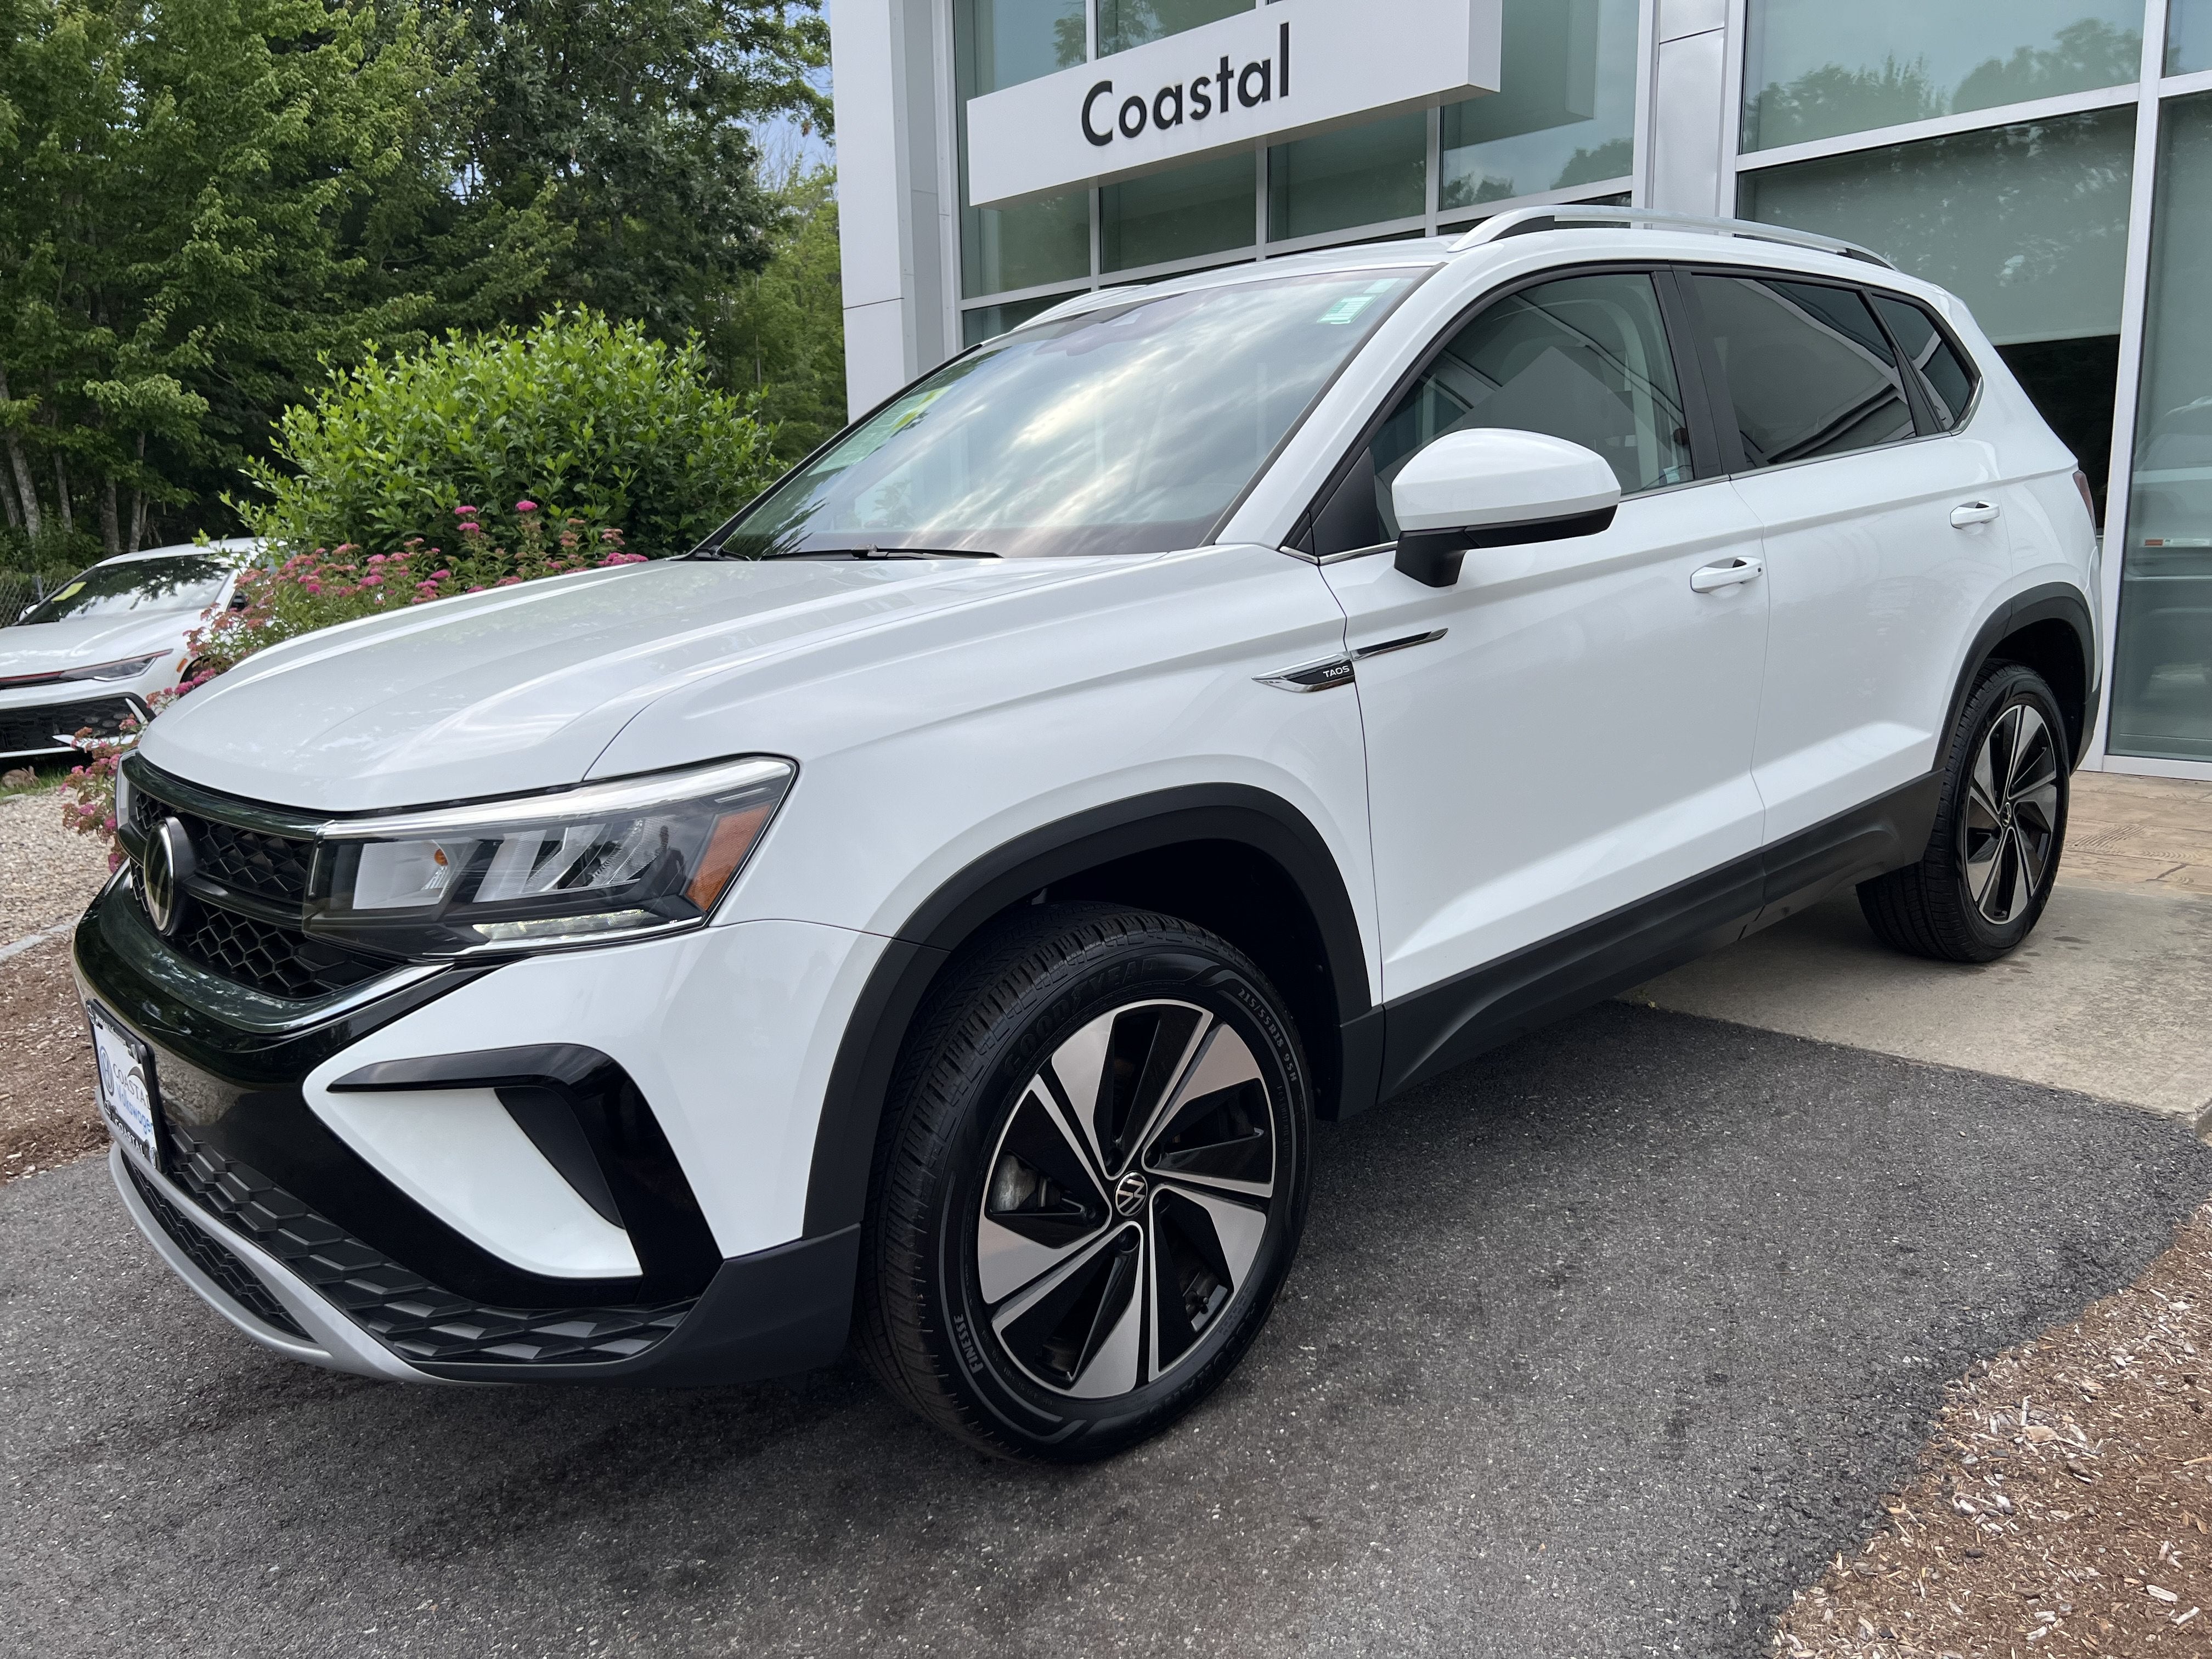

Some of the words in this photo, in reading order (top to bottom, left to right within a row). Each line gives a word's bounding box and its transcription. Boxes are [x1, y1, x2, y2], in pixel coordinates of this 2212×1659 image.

[1081, 22, 1290, 146] Coastal
[1323, 665, 1350, 678] TAOS
[1237, 987, 1285, 1049] 215/55R18
[1282, 1052, 1297, 1083] 95H
[115, 1118, 145, 1157] COASTAL
[953, 1313, 984, 1374] FINESSE
